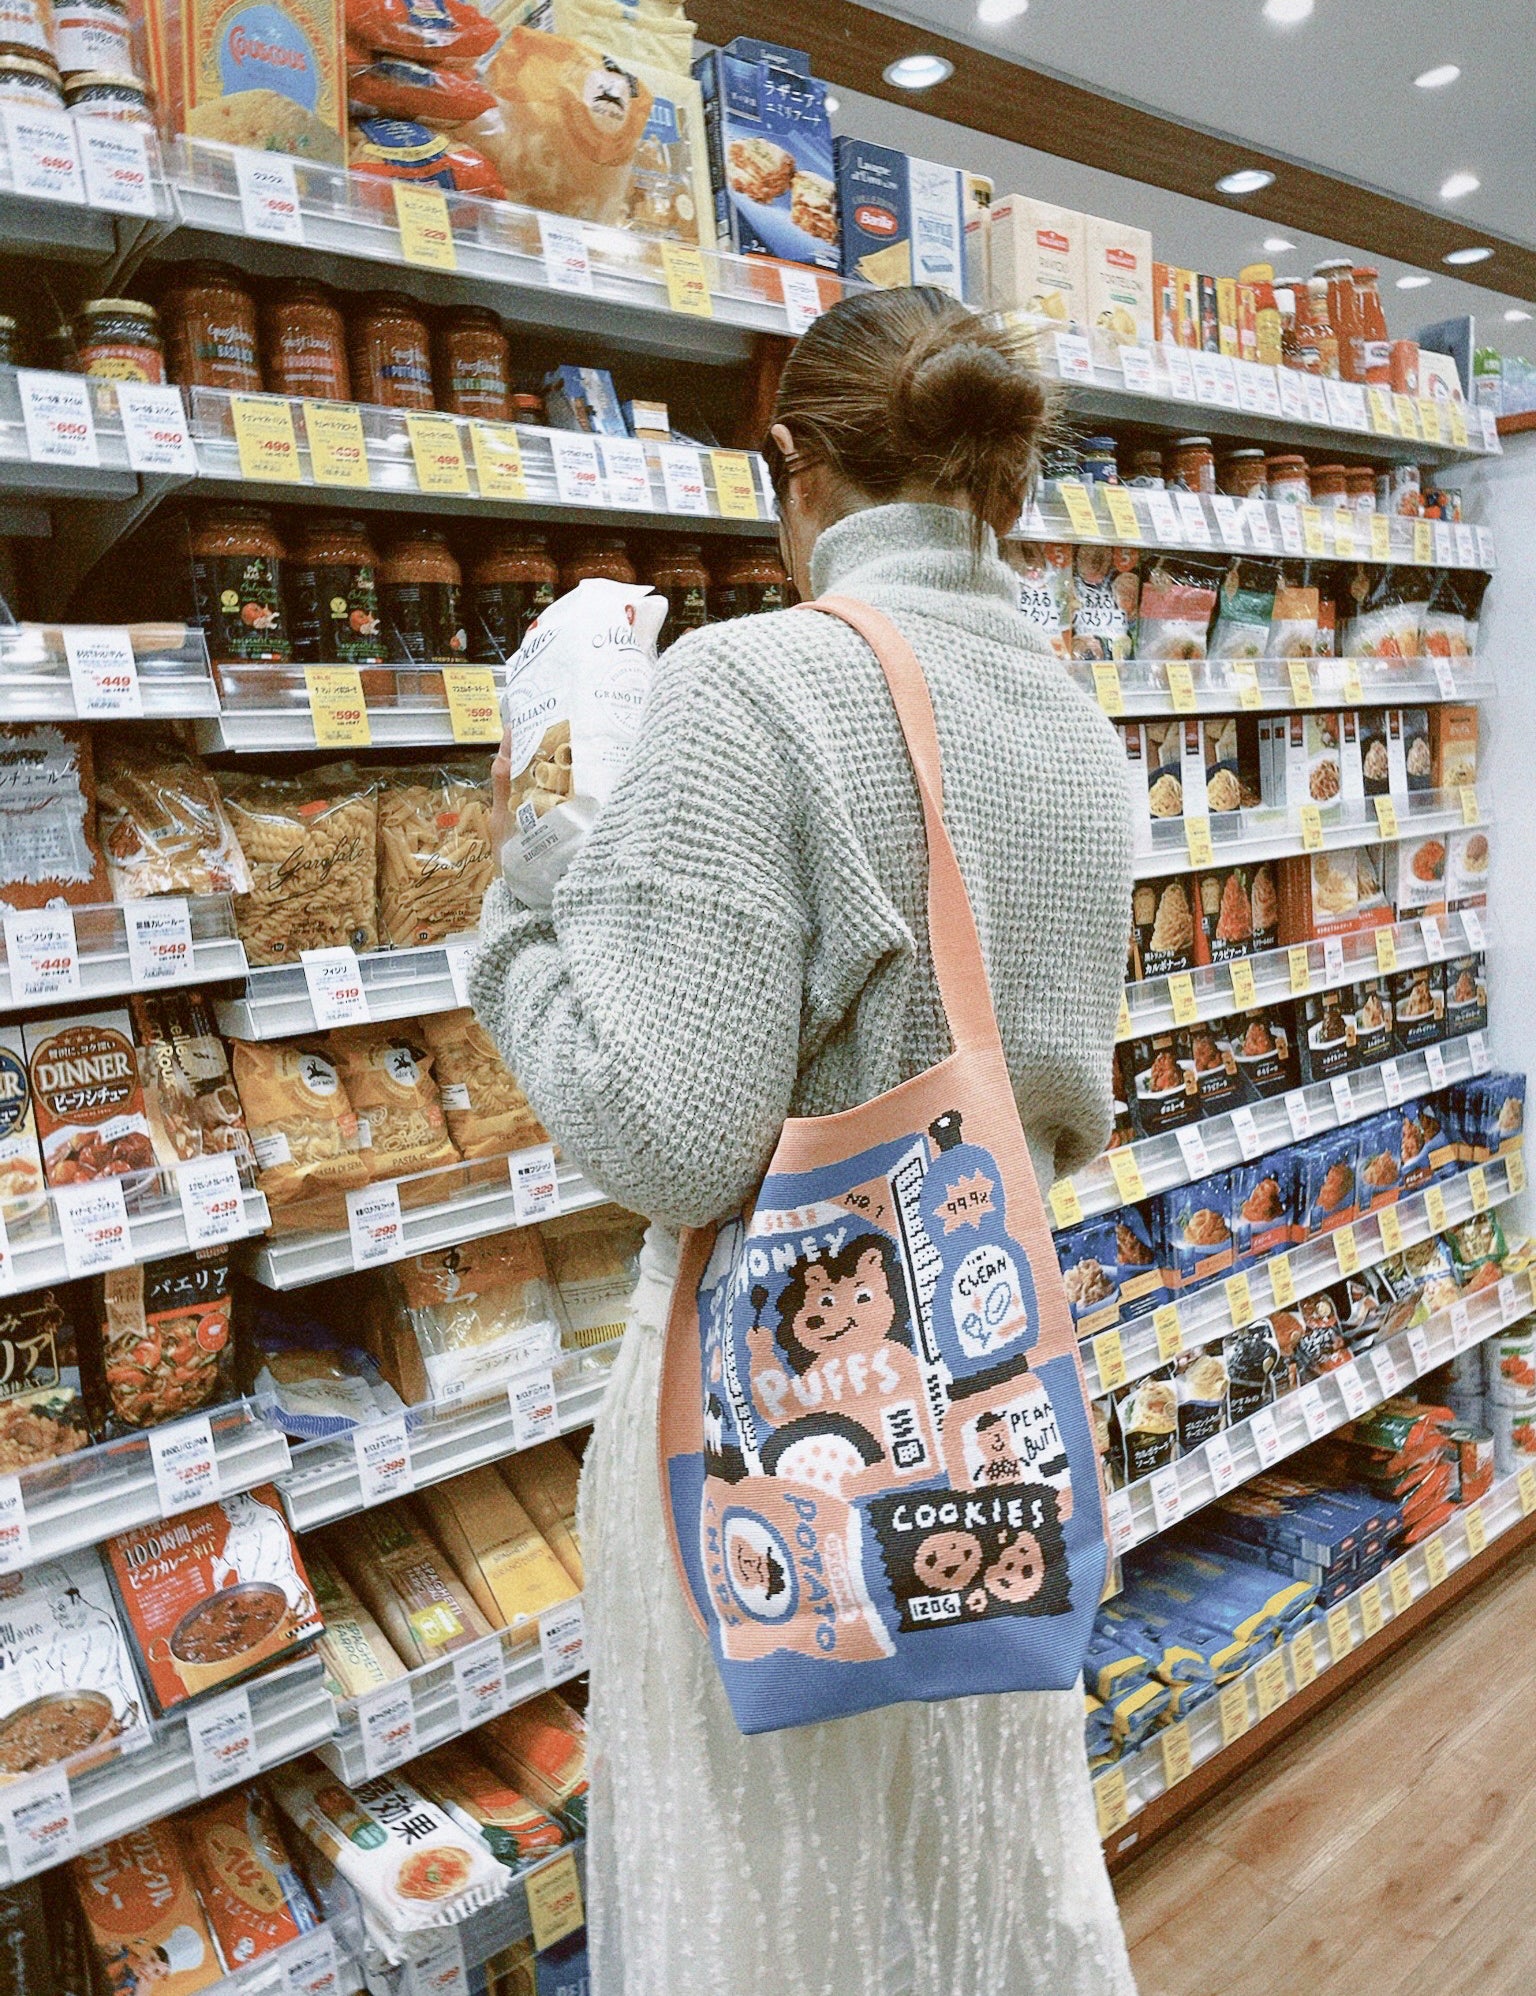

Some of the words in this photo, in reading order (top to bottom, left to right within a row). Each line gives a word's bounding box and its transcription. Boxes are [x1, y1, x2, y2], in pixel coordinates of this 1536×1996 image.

[229, 26, 307, 72] Couscous
[861, 211, 894, 230] Barilla
[264, 440, 291, 453] 499
[102, 675, 131, 688] 449
[594, 690, 631, 703] GRANO
[336, 710, 361, 721] 599
[471, 707, 493, 718] 599
[269, 836, 365, 892] Garofalo
[415, 840, 492, 888] Garofalo
[158, 942, 187, 956] 549
[40, 957, 71, 970] 449
[335, 987, 360, 1000] 519
[37, 1051, 134, 1094] DINNER
[53, 1085, 129, 1114] ビーフシチュー
[392, 1153, 419, 1168] PASTA
[210, 1199, 238, 1213] 439
[94, 1225, 123, 1242] 359
[373, 1223, 398, 1238] 299
[150, 1265, 229, 1298] パエリア
[958, 1256, 1007, 1297] CLEAN
[754, 1347, 901, 1417] PUFFS
[892, 1497, 1047, 1531] COOKIES
[783, 1492, 836, 1652] POTATO
[421, 1561, 463, 1617] SPAGHETTI
[334, 1623, 360, 1665] FARRO
[345, 1620, 387, 1683] SPAGHETTI
